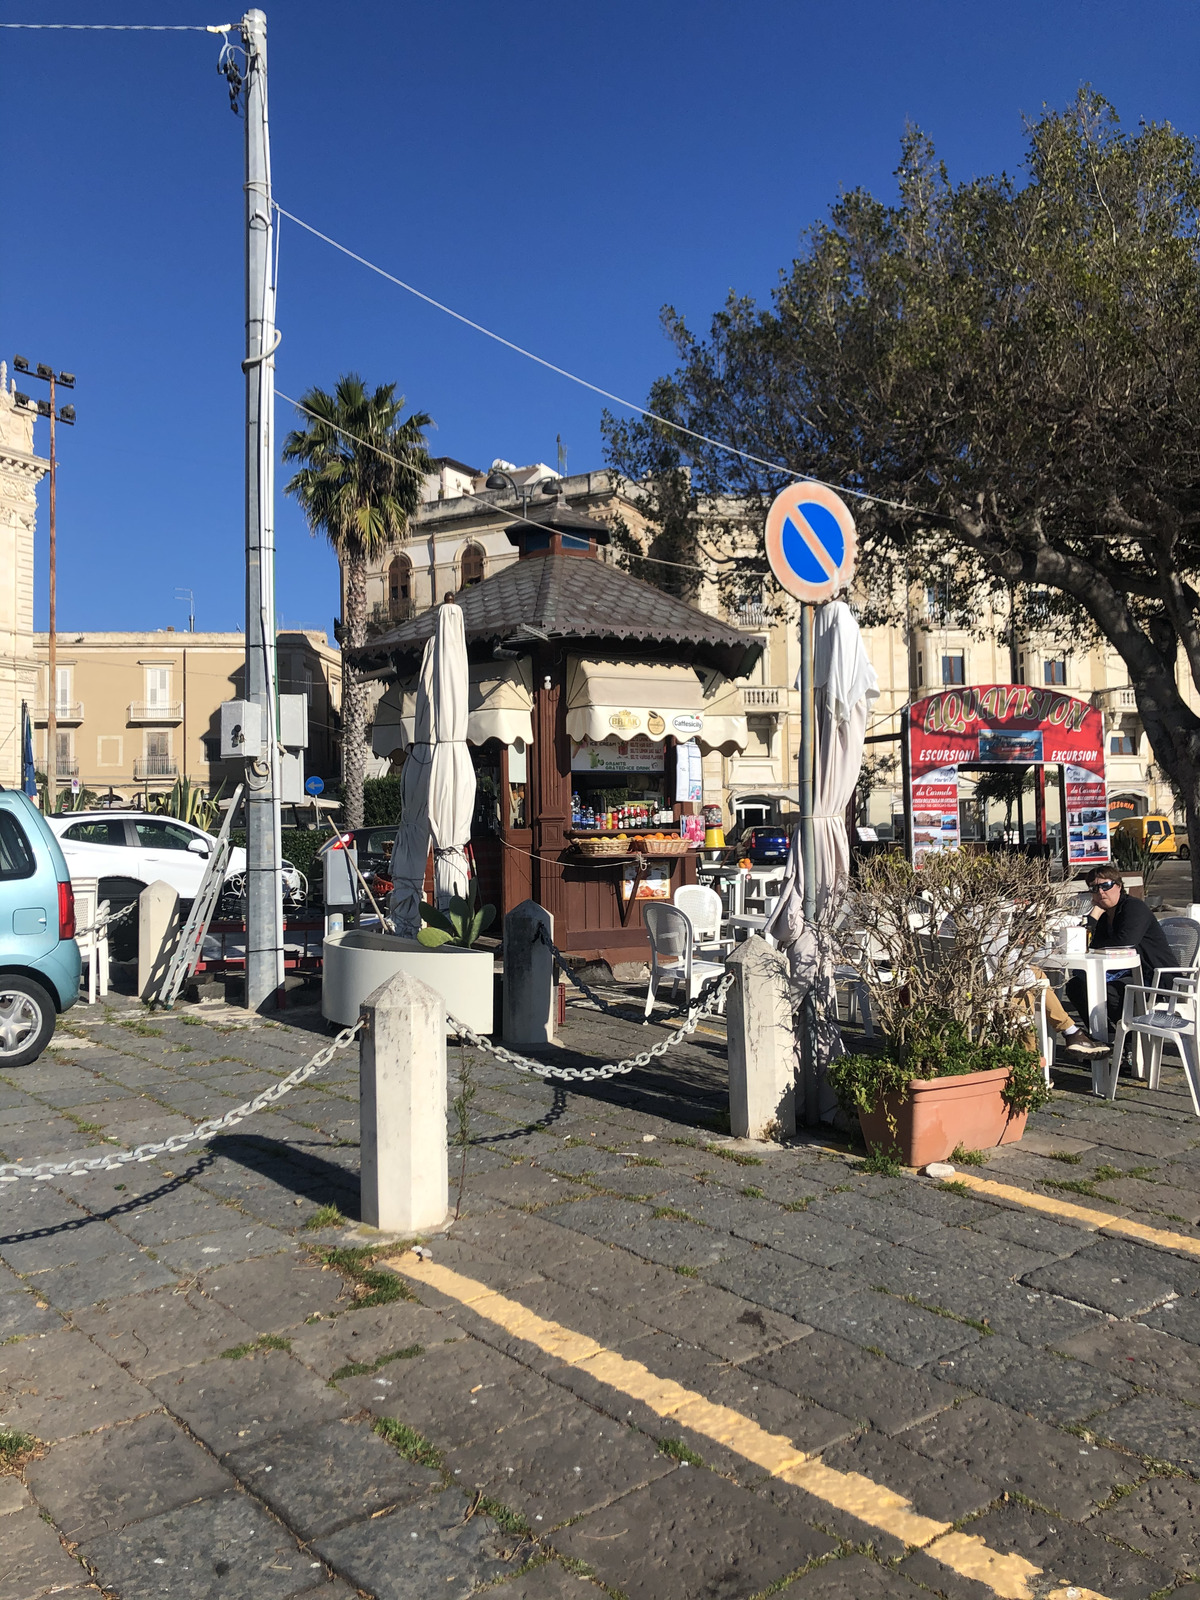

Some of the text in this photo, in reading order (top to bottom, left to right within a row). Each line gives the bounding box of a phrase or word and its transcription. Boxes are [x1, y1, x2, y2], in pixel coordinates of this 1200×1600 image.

[924, 686, 1090, 735] AQUAVISION
[919, 749, 976, 762] ESCURSIONI
[1051, 750, 1098, 762] EXCURSION
[916, 786, 952, 796] da Carmelo
[1070, 785, 1102, 794] da Carmelo
[1108, 801, 1134, 811] PIZZERIA
